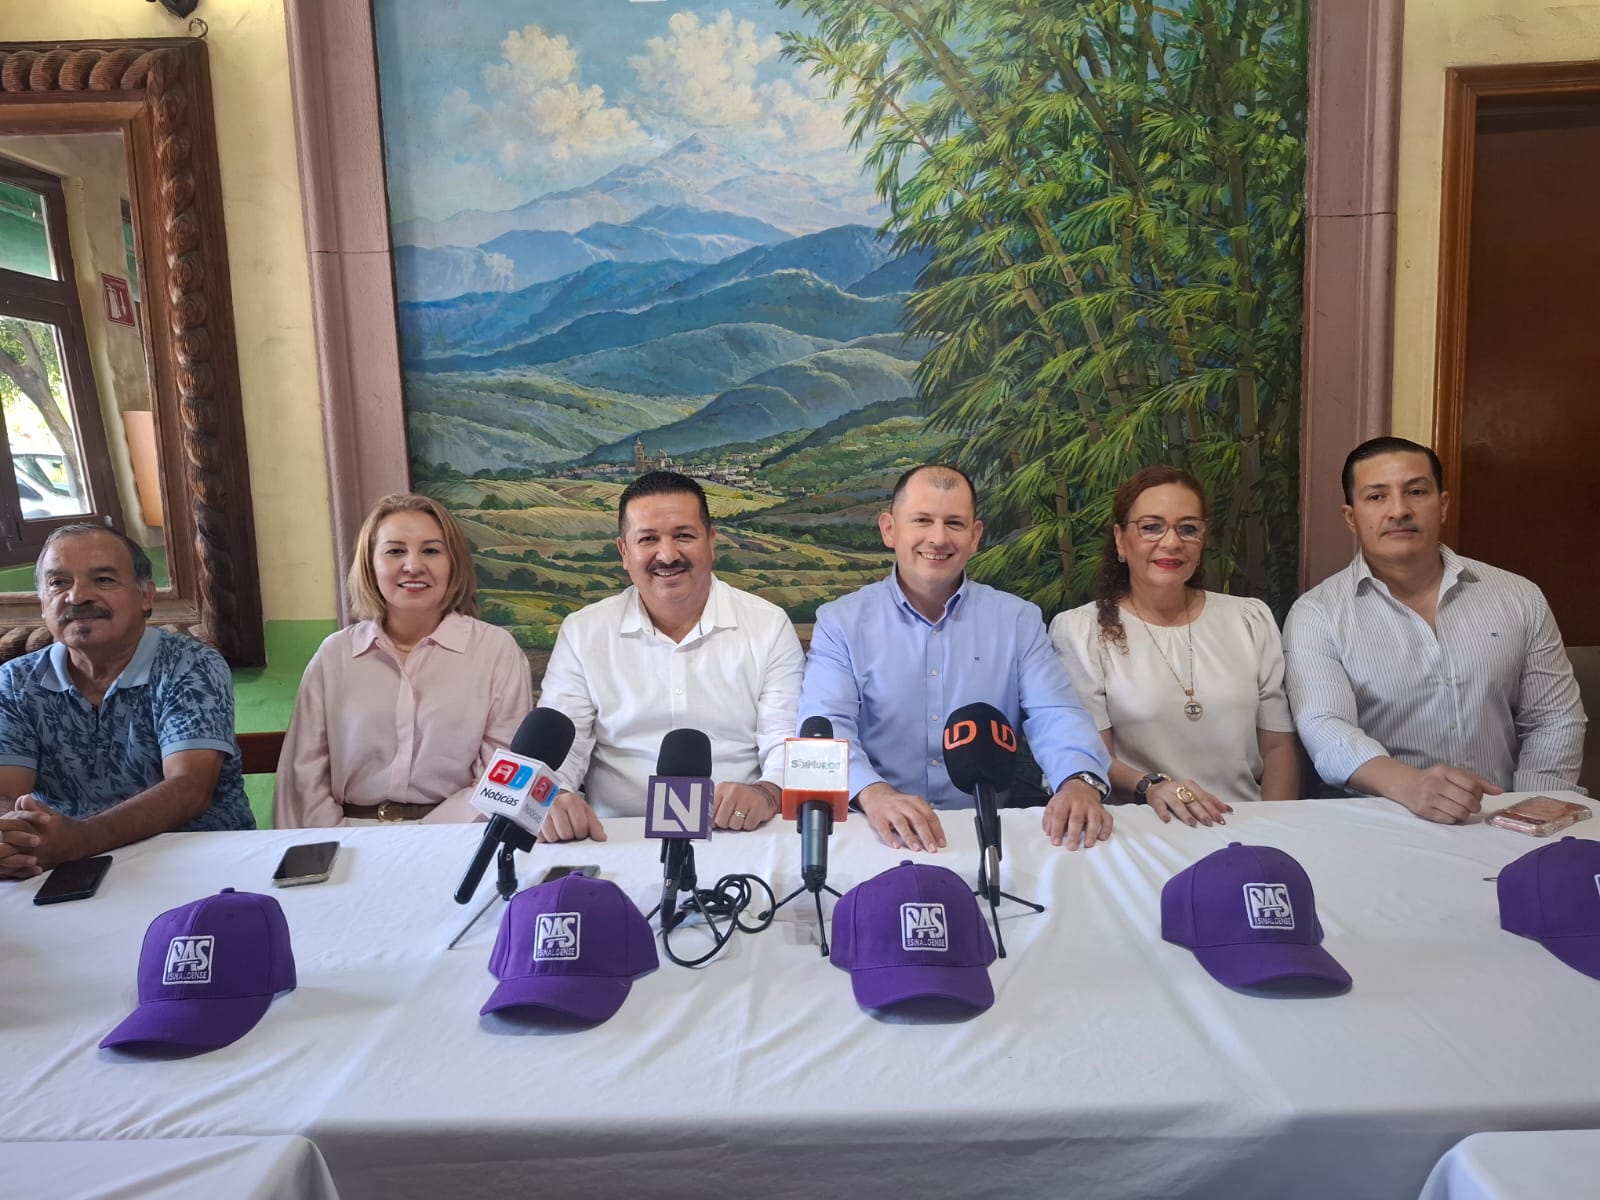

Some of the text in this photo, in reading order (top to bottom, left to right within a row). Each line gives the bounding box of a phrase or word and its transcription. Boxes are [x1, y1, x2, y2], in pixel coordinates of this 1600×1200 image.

[480, 787, 519, 807] Noticias
[652, 783, 702, 832] LN
[1250, 887, 1290, 918] PAS
[538, 917, 576, 949] PAS
[906, 907, 945, 939] PAS
[168, 940, 210, 973] PAS
